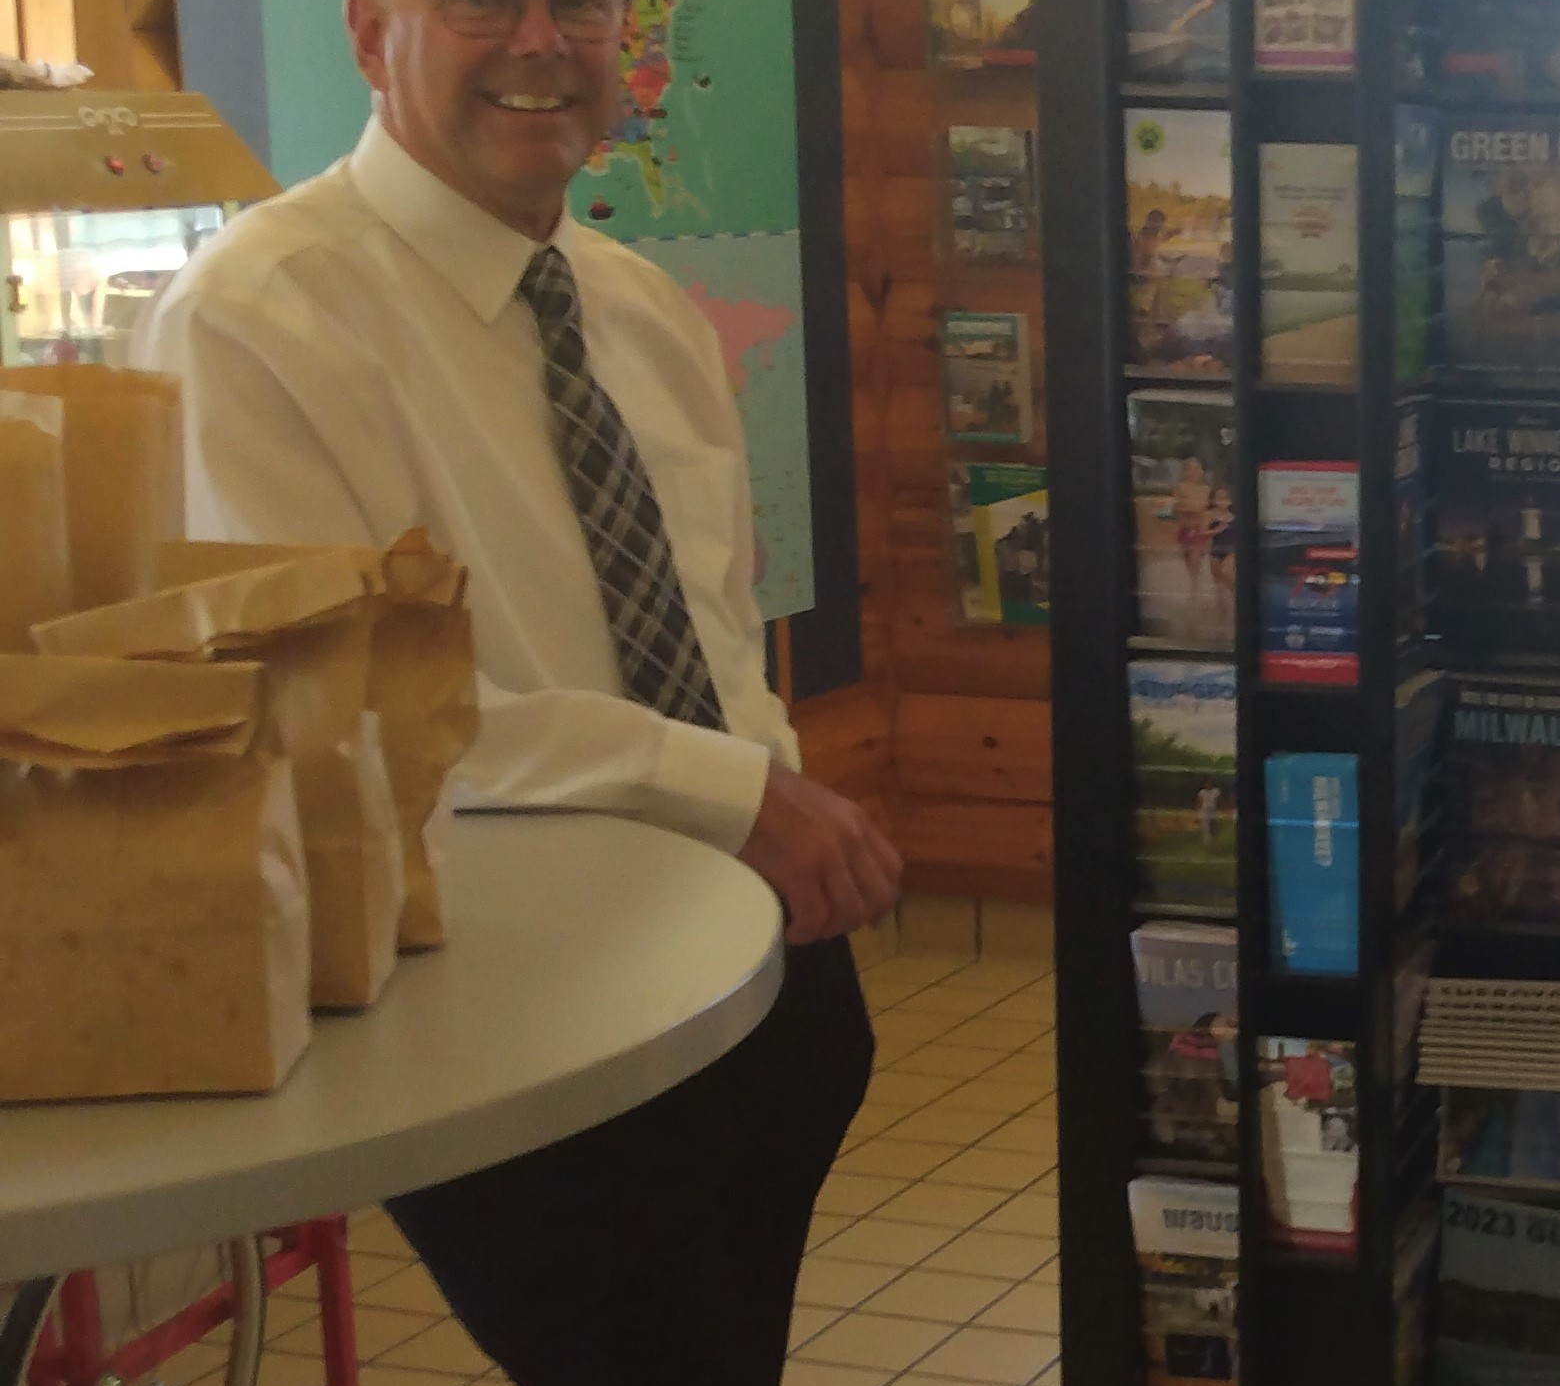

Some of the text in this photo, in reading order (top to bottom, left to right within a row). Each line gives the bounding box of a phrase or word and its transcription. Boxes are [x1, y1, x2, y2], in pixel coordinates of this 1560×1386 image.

[1450, 130, 1551, 162] GREEN
[1453, 428, 1498, 454] LAKE
[1447, 1200, 1517, 1239] 2023
